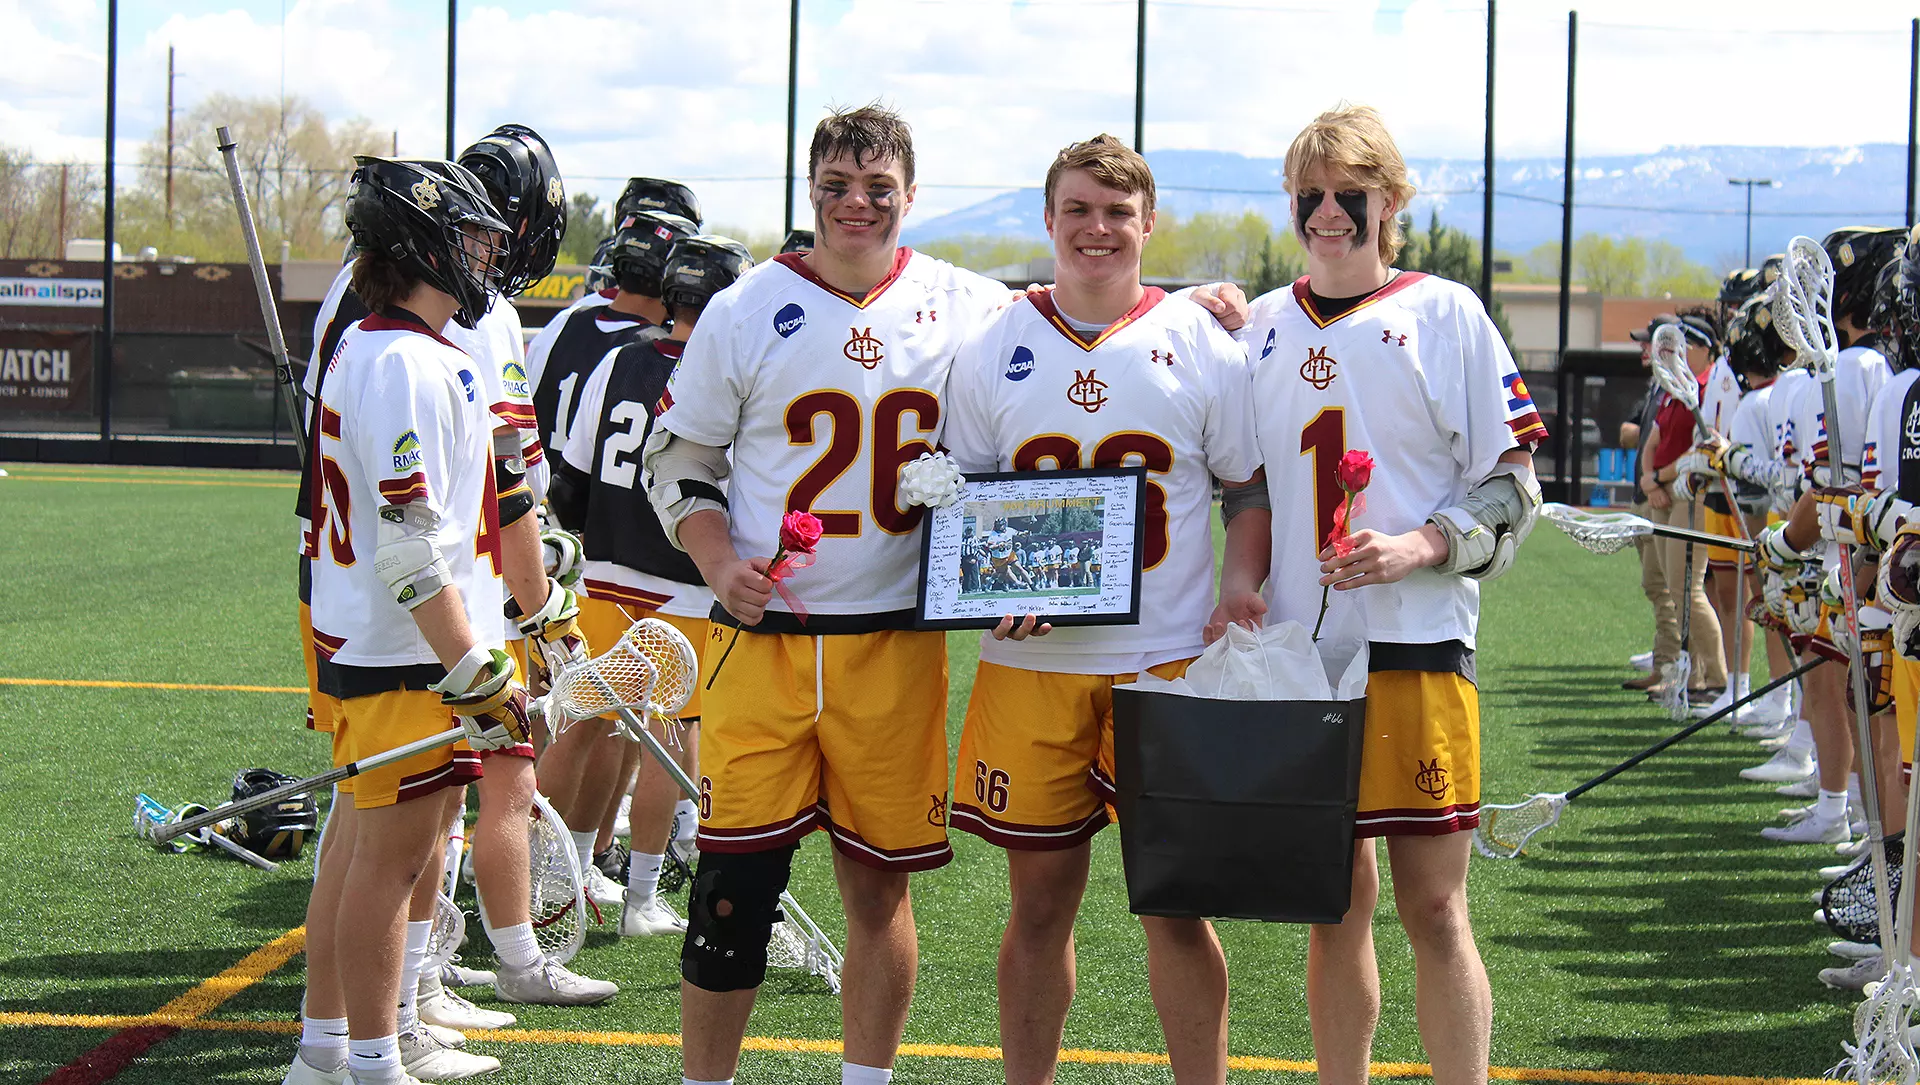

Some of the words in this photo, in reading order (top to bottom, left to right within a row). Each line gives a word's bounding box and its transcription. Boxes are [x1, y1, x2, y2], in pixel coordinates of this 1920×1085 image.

[778, 315, 804, 333] NCAA
[30, 387, 69, 398] LUNCH
[784, 387, 940, 538] 26
[974, 759, 1011, 814] 66
